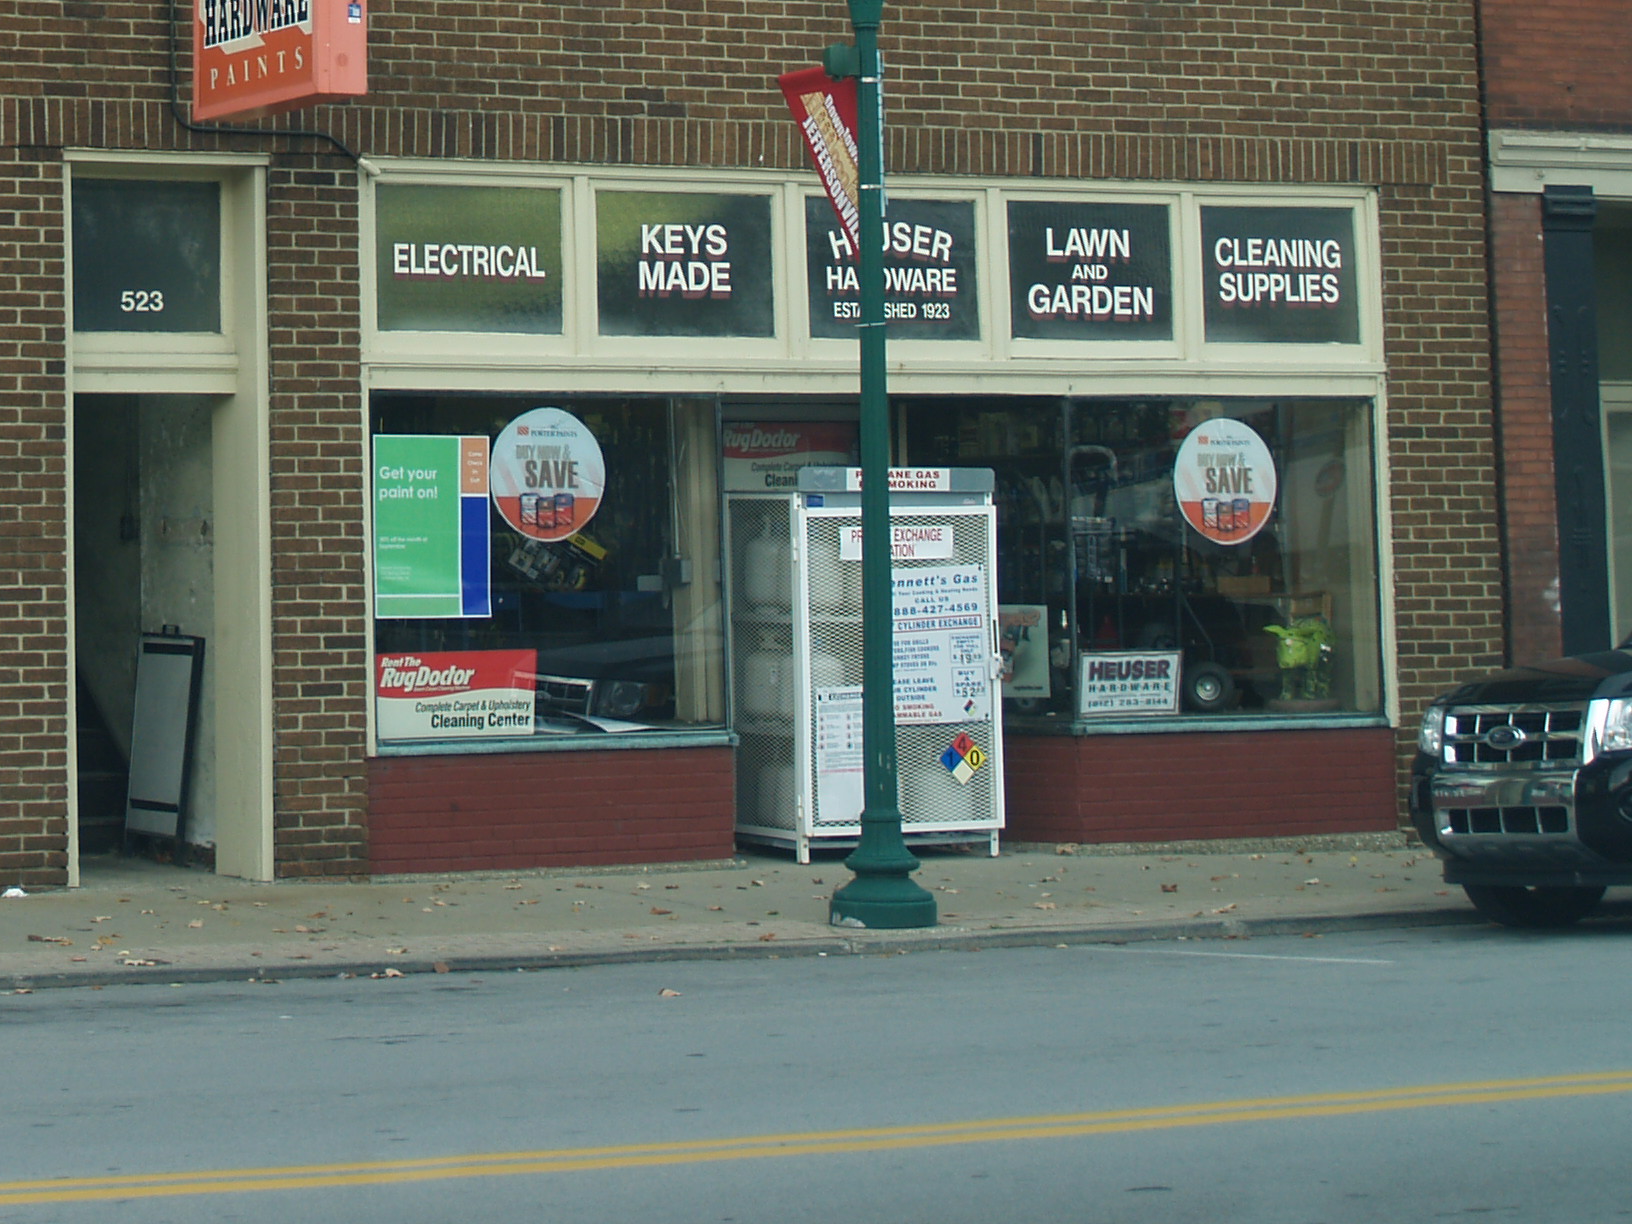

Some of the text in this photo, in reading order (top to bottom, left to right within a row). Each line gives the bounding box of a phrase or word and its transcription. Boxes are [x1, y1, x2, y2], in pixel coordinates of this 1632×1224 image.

[210, 45, 304, 90] PAINTS
[640, 223, 728, 256] KEYS
[827, 221, 953, 262] HSER
[1045, 227, 1131, 259] LAWN
[393, 242, 546, 278] ELECTRICAL
[1214, 237, 1342, 269] CLEANING
[638, 260, 732, 292] MADE
[826, 266, 957, 292] HAWARE
[1071, 264, 1108, 281] AND
[1219, 272, 1339, 304] SUPPLIES
[120, 290, 165, 313] 523
[1027, 283, 1154, 316] GARDEN
[833, 302, 951, 319] ESTSHED 1923
[379, 466, 438, 483] Get your
[525, 460, 579, 488] SAVE
[916, 470, 941, 479] GAS
[1206, 467, 1253, 494] SAVE
[379, 485, 438, 501] paint on!
[888, 480, 937, 489] MOKING
[893, 528, 943, 542] EXCHANGE
[953, 574, 978, 585] Gas
[897, 617, 978, 631] CYLINDER EXCHANGE
[381, 656, 422, 668] Rent The
[1088, 659, 1171, 682] HEUSER
[380, 665, 475, 693] RugDoctor
[415, 698, 531, 714] Complete Carpet & Upholstery
[431, 712, 530, 730] Cleaning Center
[958, 738, 967, 750] 4
[947, 751, 954, 765] 1
[970, 750, 980, 766] 0
